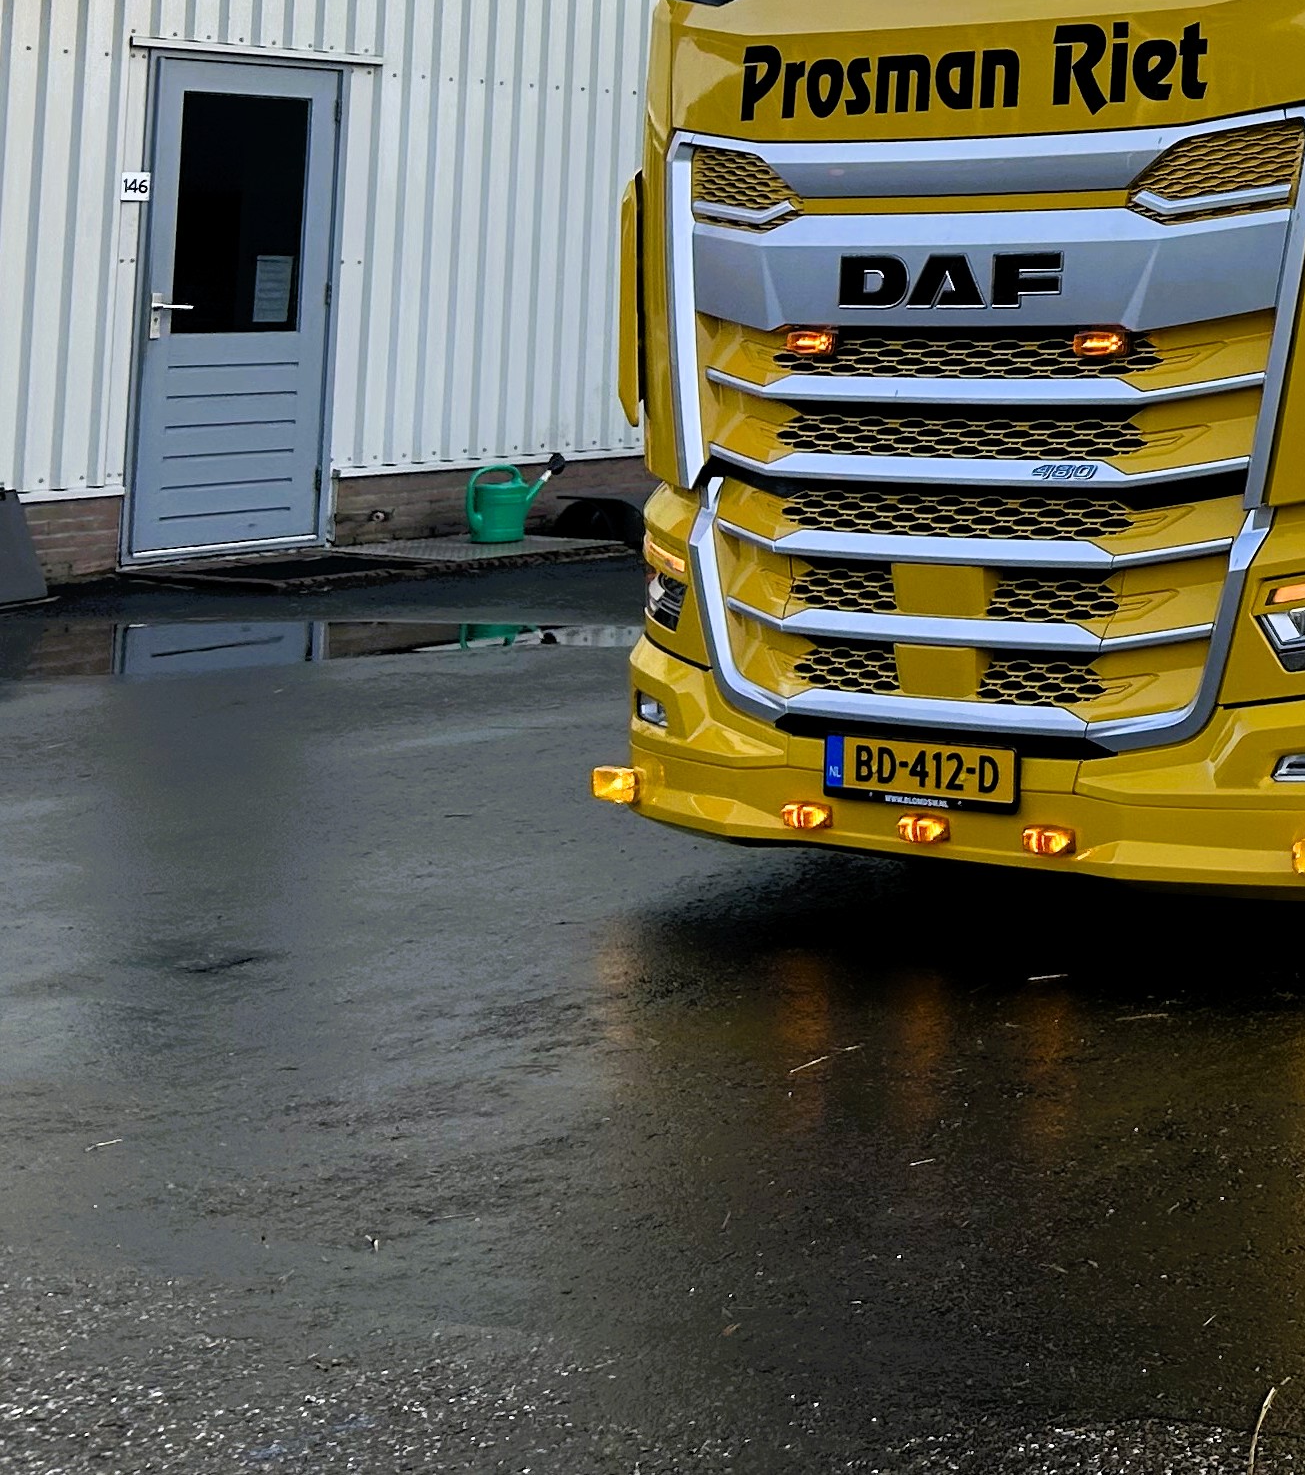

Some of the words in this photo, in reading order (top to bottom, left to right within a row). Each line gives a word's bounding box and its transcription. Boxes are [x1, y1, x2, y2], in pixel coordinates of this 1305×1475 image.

[740, 43, 1020, 122] Prosman
[1052, 21, 1208, 116] Riet
[123, 178, 149, 194] 146
[838, 251, 1064, 310] DAF
[1031, 464, 1099, 480] 480
[829, 765, 842, 778] NL
[855, 744, 1000, 794] BD-412-D
